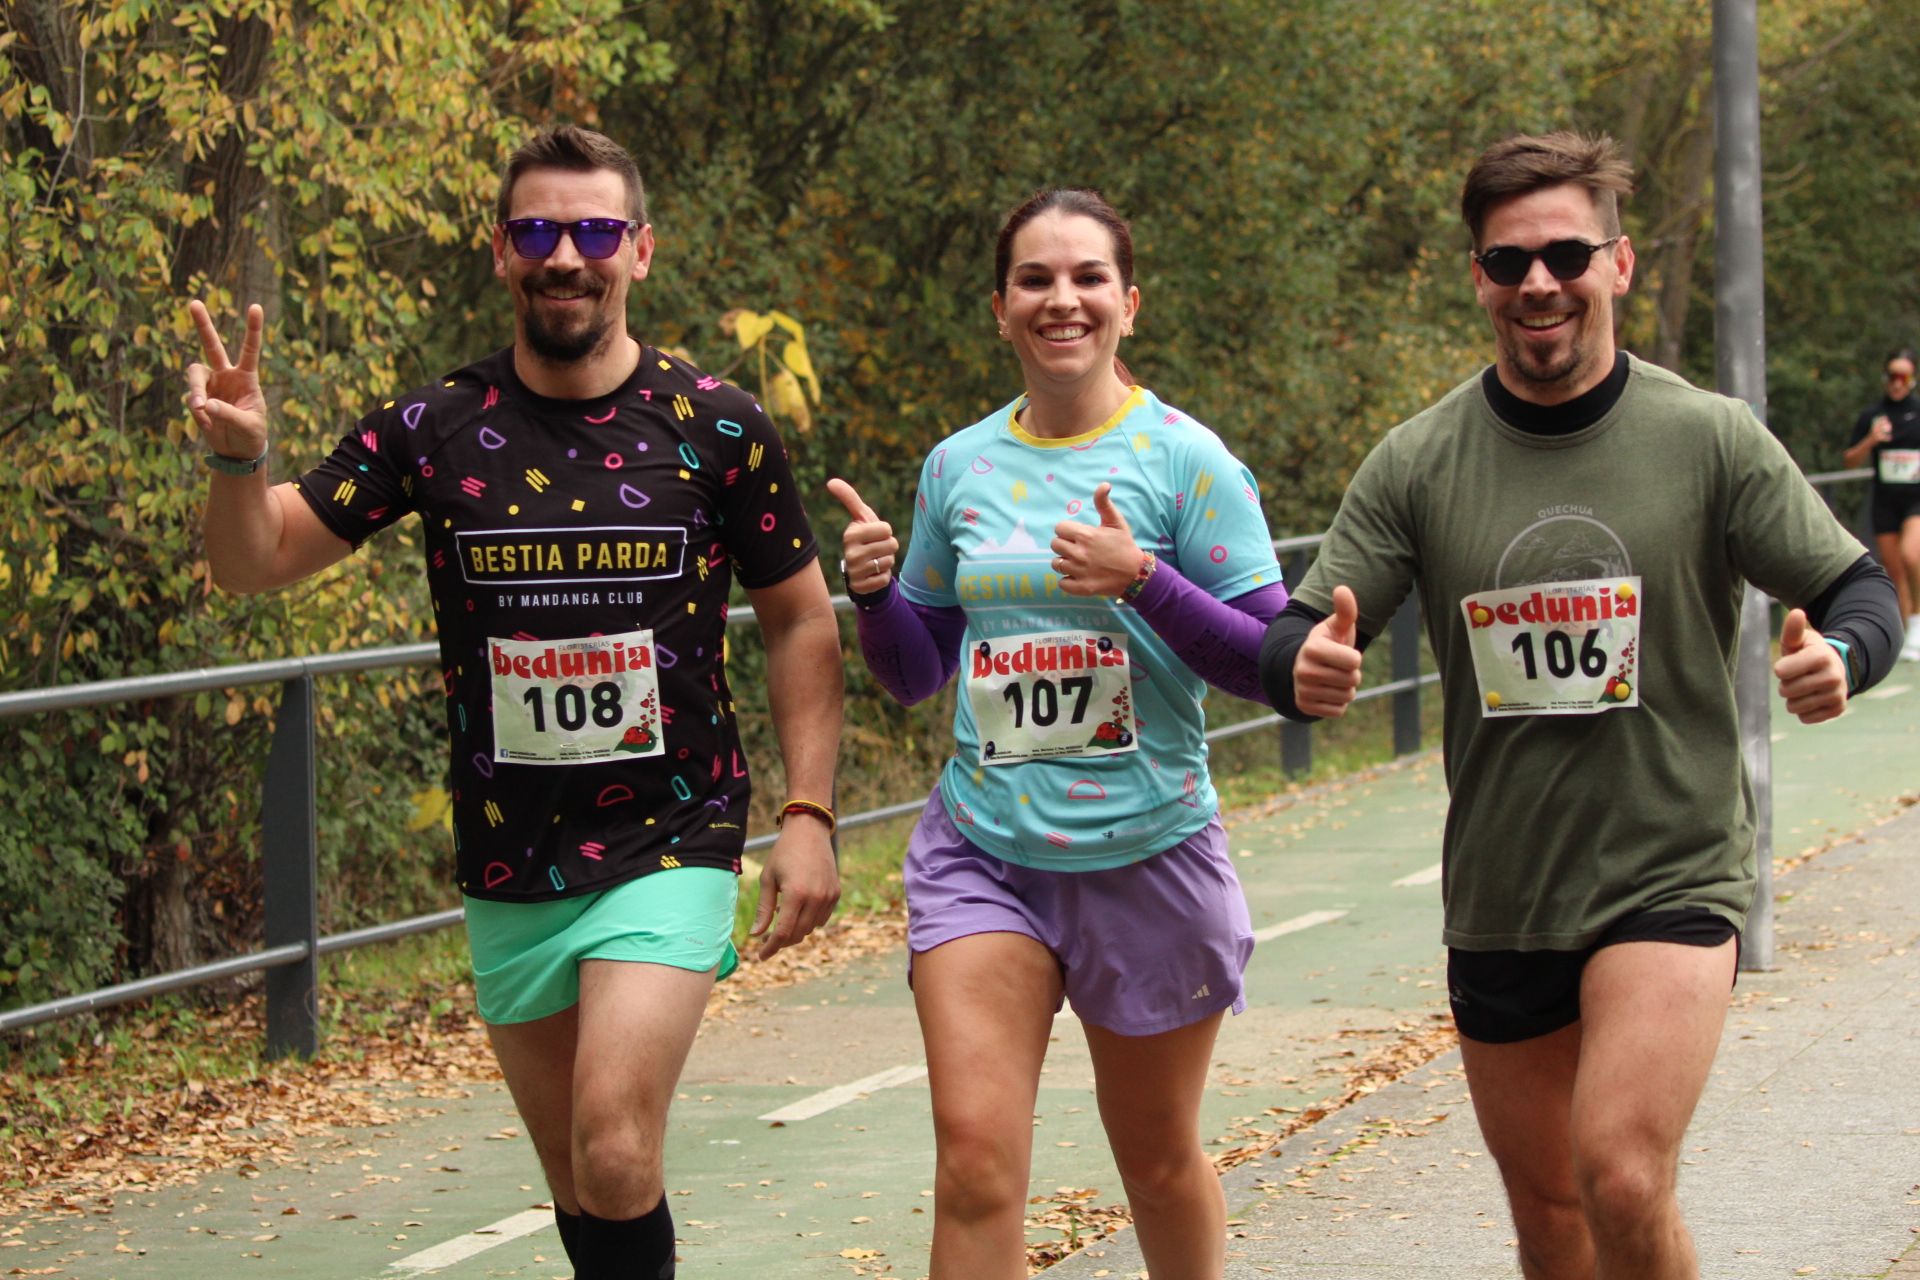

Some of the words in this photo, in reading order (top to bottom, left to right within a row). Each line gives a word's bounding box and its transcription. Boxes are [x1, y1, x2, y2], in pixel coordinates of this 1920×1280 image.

[1538, 504, 1593, 518] QUECHUA
[470, 544, 564, 573] BESTIA
[578, 542, 667, 570] PARDA
[499, 595, 514, 607] BY
[521, 593, 600, 606] MANDANGA
[608, 591, 643, 604] CLUB
[1466, 587, 1637, 629] bedunia
[492, 642, 652, 679] bedunia
[972, 639, 1125, 679] bedunia
[1511, 628, 1608, 680] 106
[523, 681, 624, 733] 108
[1003, 676, 1093, 729] 107
